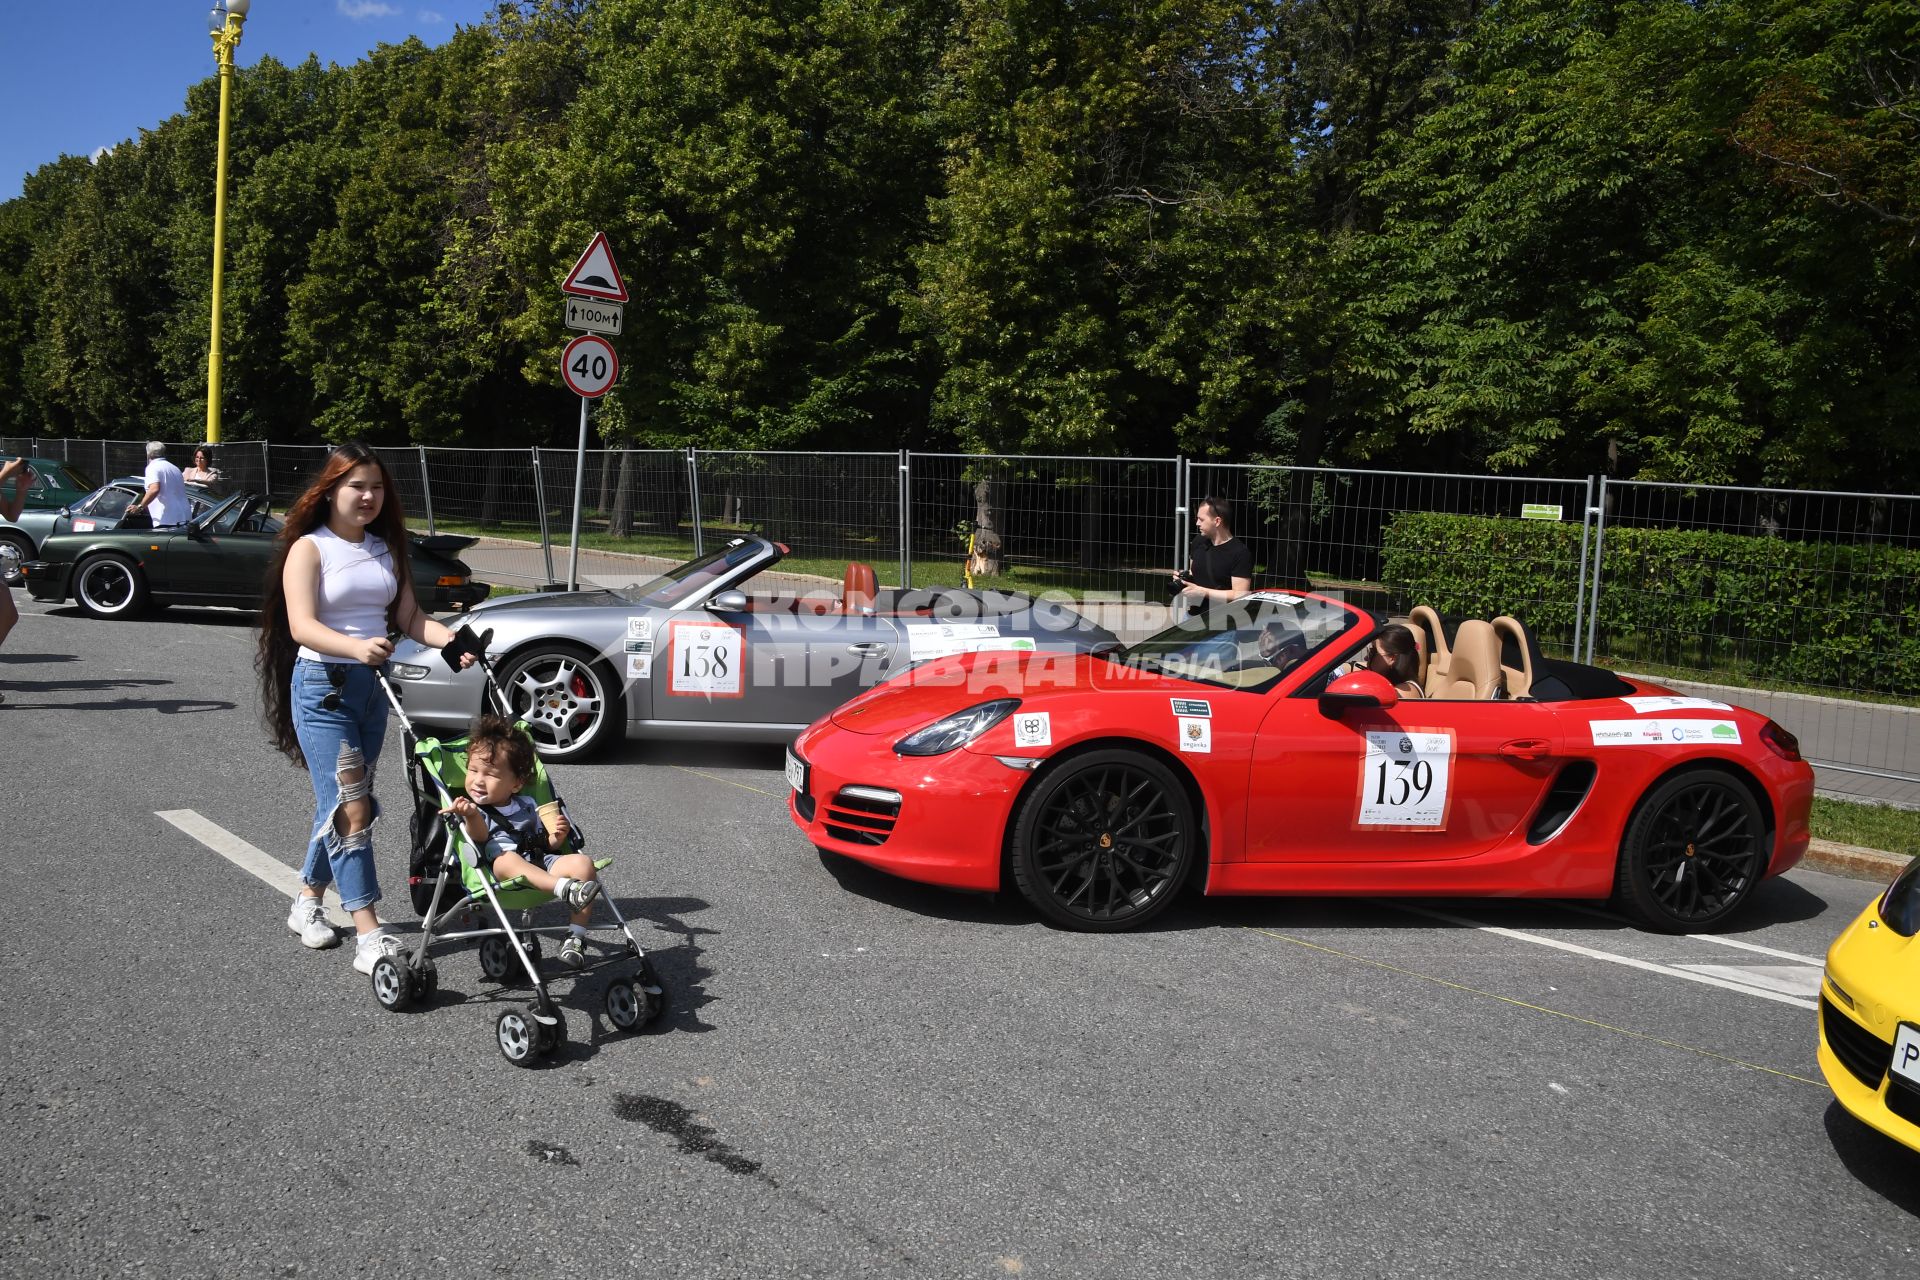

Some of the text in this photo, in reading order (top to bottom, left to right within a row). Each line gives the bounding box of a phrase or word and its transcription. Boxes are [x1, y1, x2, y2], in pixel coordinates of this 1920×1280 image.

[571, 353, 607, 380] 40
[683, 645, 728, 679] 138
[1375, 760, 1433, 806] 139
